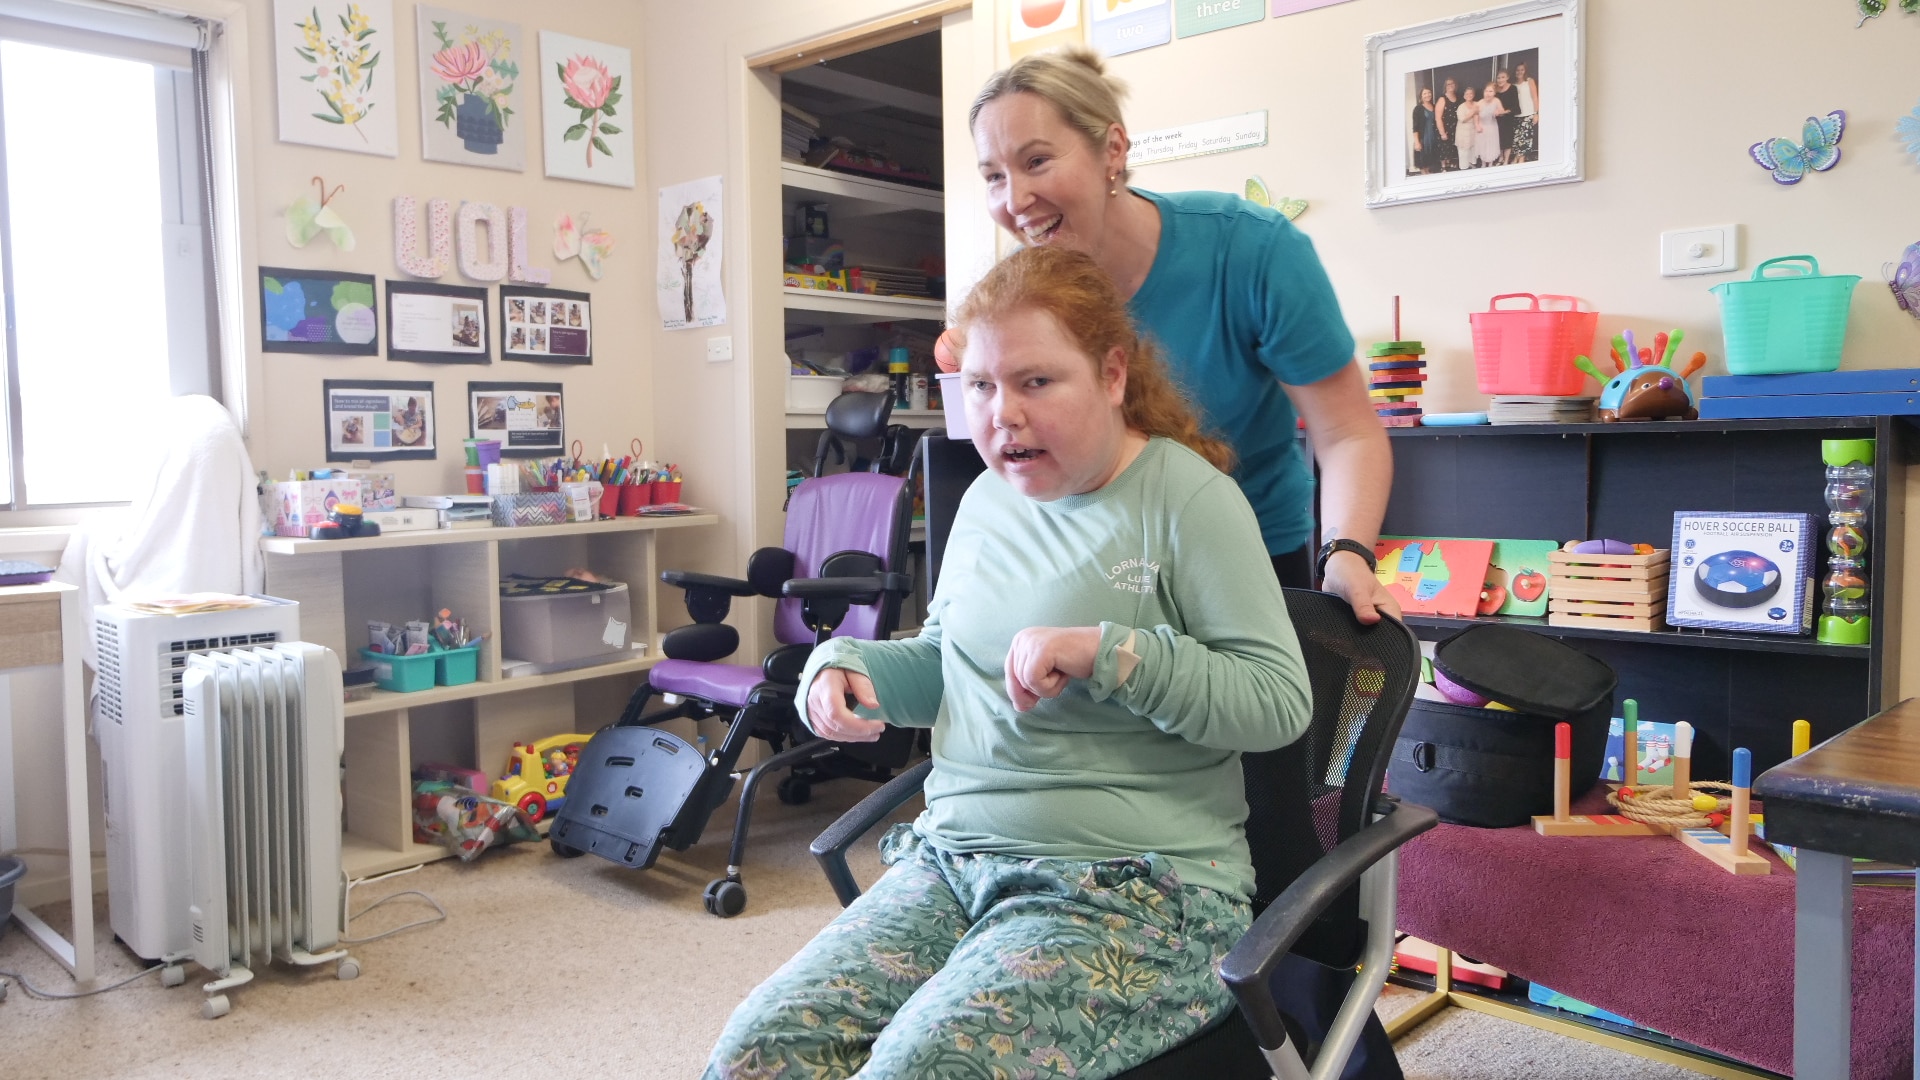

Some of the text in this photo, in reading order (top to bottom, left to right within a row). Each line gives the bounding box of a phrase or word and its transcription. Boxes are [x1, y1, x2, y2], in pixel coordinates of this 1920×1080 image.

[1196, 0, 1241, 18] three
[1117, 24, 1144, 39] two
[1130, 131, 1183, 147] ays of the week
[1147, 146, 1174, 157] Thursday
[1178, 140, 1198, 150] Friday
[1202, 135, 1231, 146] Saturday
[1235, 130, 1261, 141] Sunday
[1684, 521, 1795, 533] HOVER SOCCER BALL
[1104, 558, 1145, 580] LORNA
[1127, 573, 1151, 583] LUE
